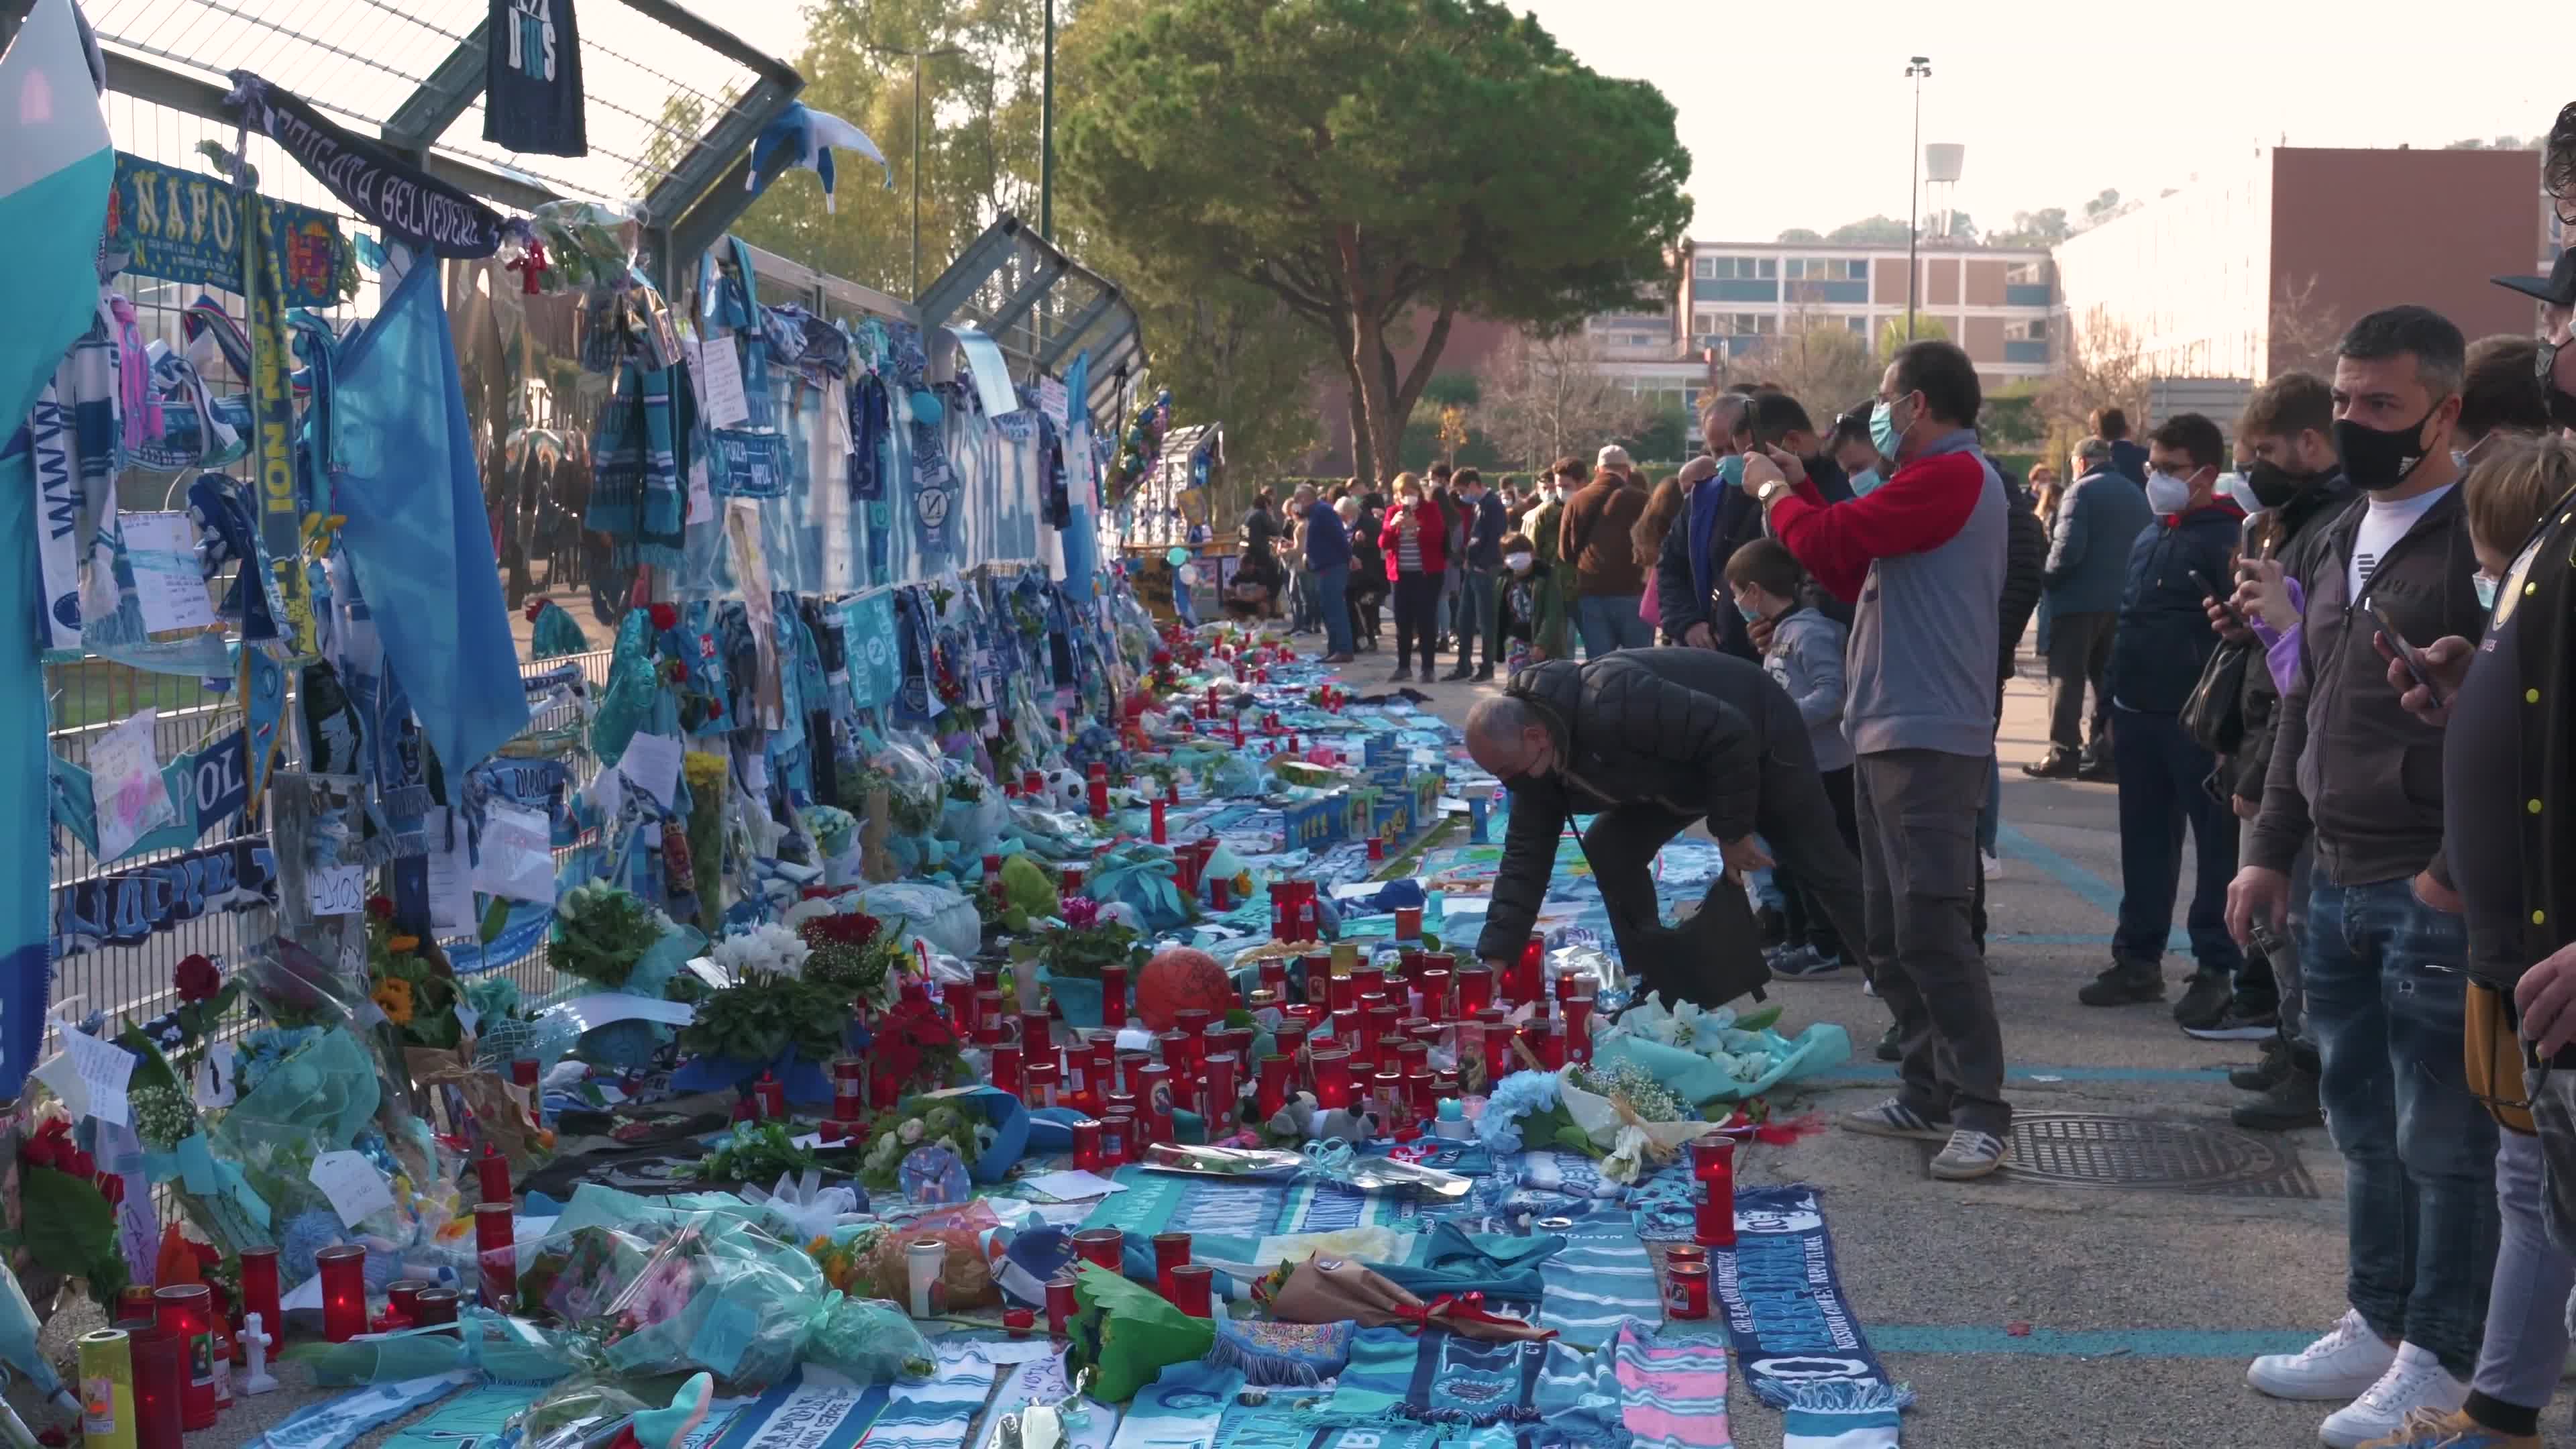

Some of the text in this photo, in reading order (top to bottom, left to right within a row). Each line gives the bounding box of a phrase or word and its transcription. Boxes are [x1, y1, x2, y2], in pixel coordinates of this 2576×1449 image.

[133, 170, 234, 253] NAPO
[381, 174, 482, 246] BELVEDERE
[168, 747, 246, 827] POL
